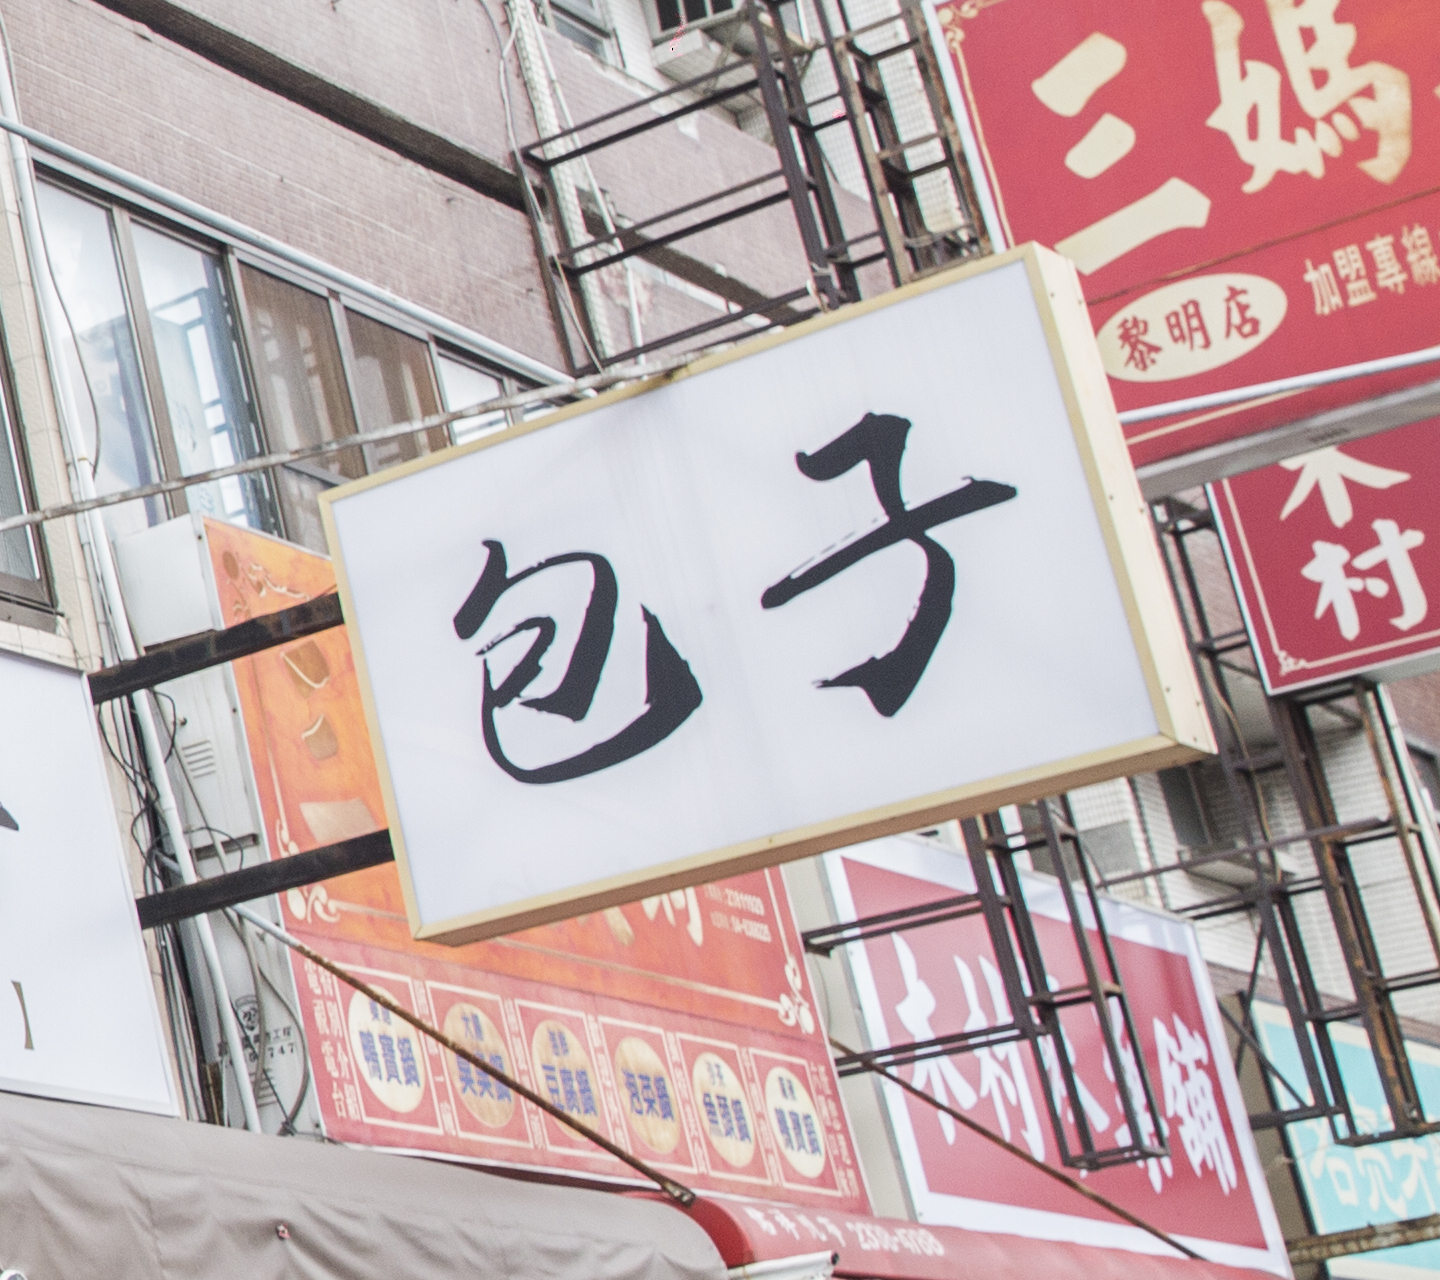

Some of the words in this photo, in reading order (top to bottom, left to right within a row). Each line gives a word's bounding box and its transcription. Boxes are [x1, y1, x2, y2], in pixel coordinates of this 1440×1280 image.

[1302, 223, 1440, 317] 加盟專線
[1117, 285, 1261, 372] 黎明店
[453, 412, 1017, 783] 包子
